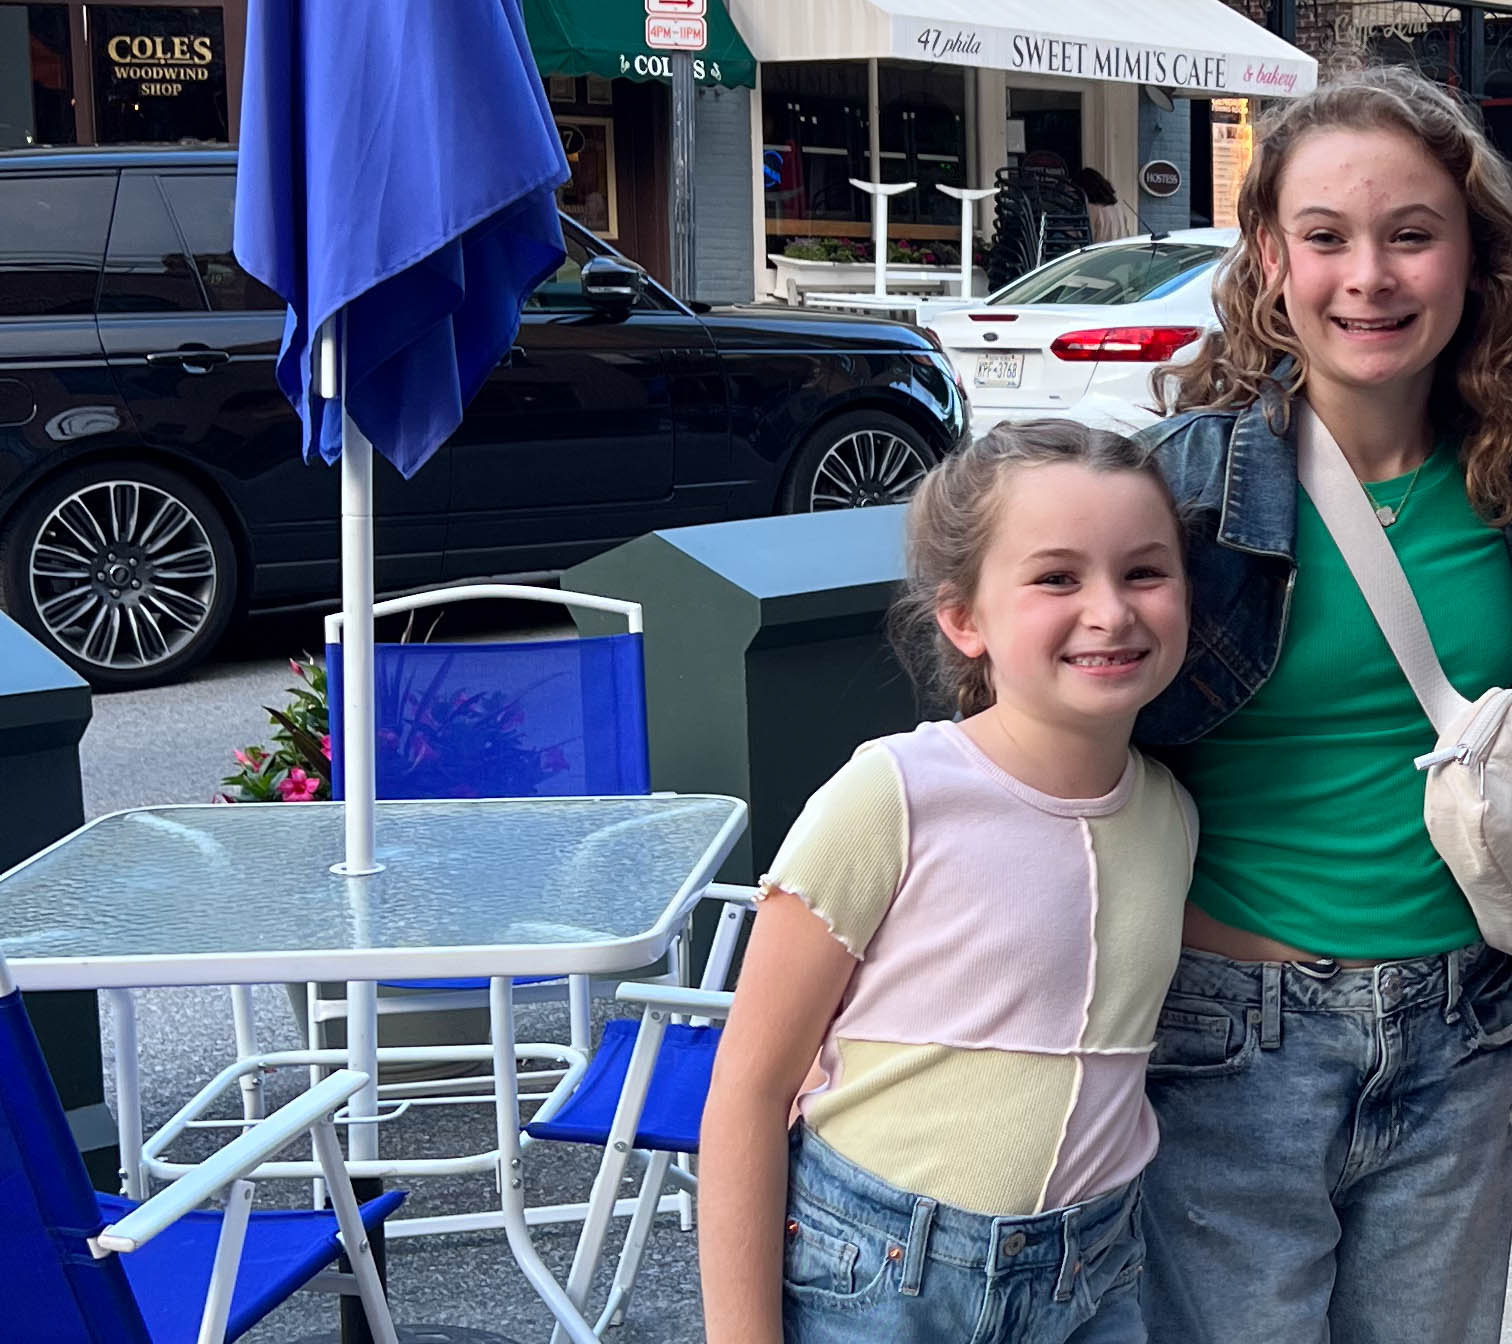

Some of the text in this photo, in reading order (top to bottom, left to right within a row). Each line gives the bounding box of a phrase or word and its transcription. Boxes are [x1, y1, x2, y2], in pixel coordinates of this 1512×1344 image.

[108, 35, 213, 65] COLE'S
[917, 28, 982, 58] 47 phila
[114, 66, 209, 81] WOODWIND
[1012, 34, 1227, 89] SWEET MIMI'S CAFÉ
[141, 82, 183, 96] SHOP
[1243, 63, 1298, 94] & bakery
[1146, 171, 1178, 185] HOSTESS
